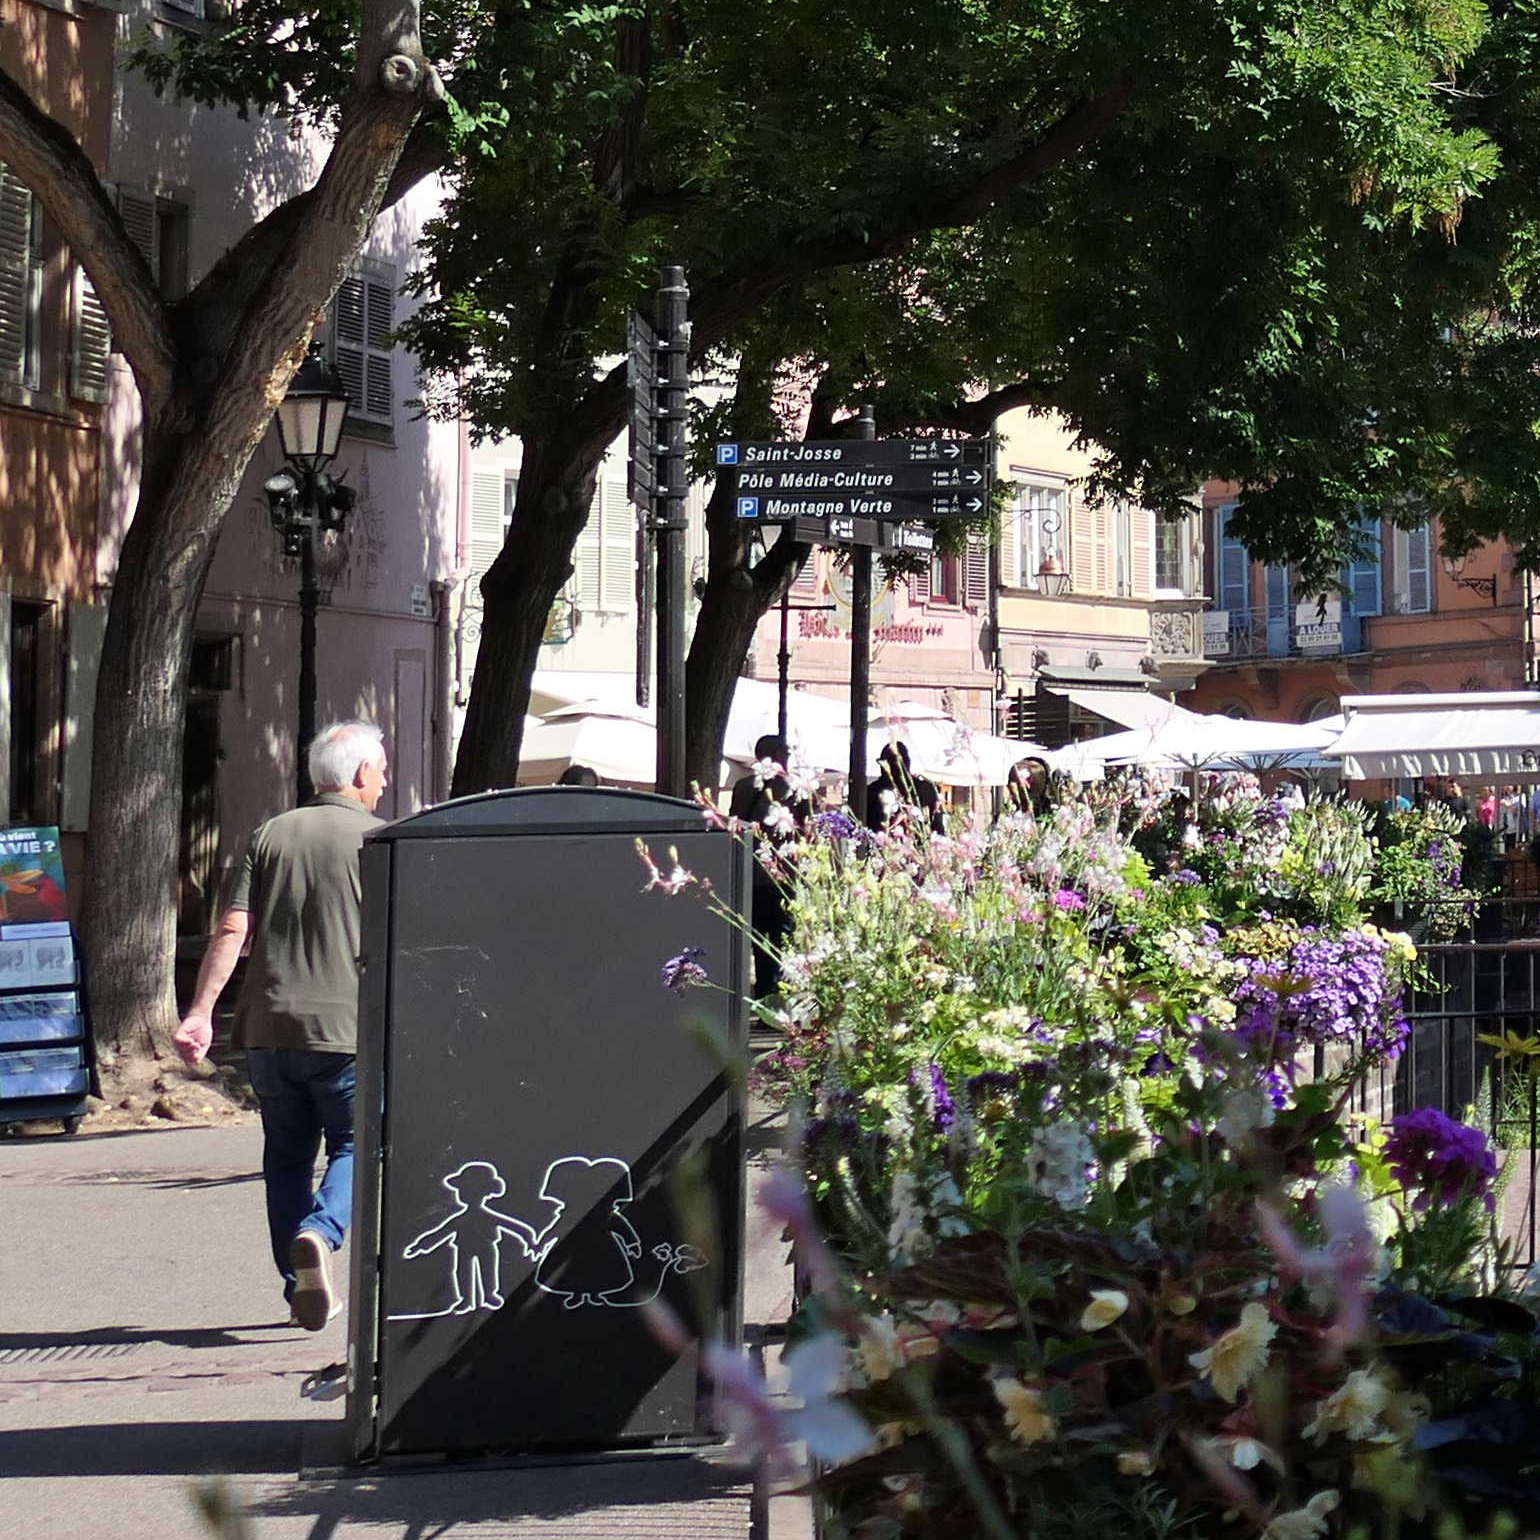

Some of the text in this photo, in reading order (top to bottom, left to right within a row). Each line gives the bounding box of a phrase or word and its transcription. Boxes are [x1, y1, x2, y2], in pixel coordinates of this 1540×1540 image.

[721, 445, 842, 462] P Saint-Josse
[738, 471, 894, 489] Pôle Média-Culture
[741, 498, 893, 517] P Montagne Verte
[1308, 623, 1339, 635] LOUER
[6, 831, 37, 840] vient
[7, 841, 41, 854] VIE
